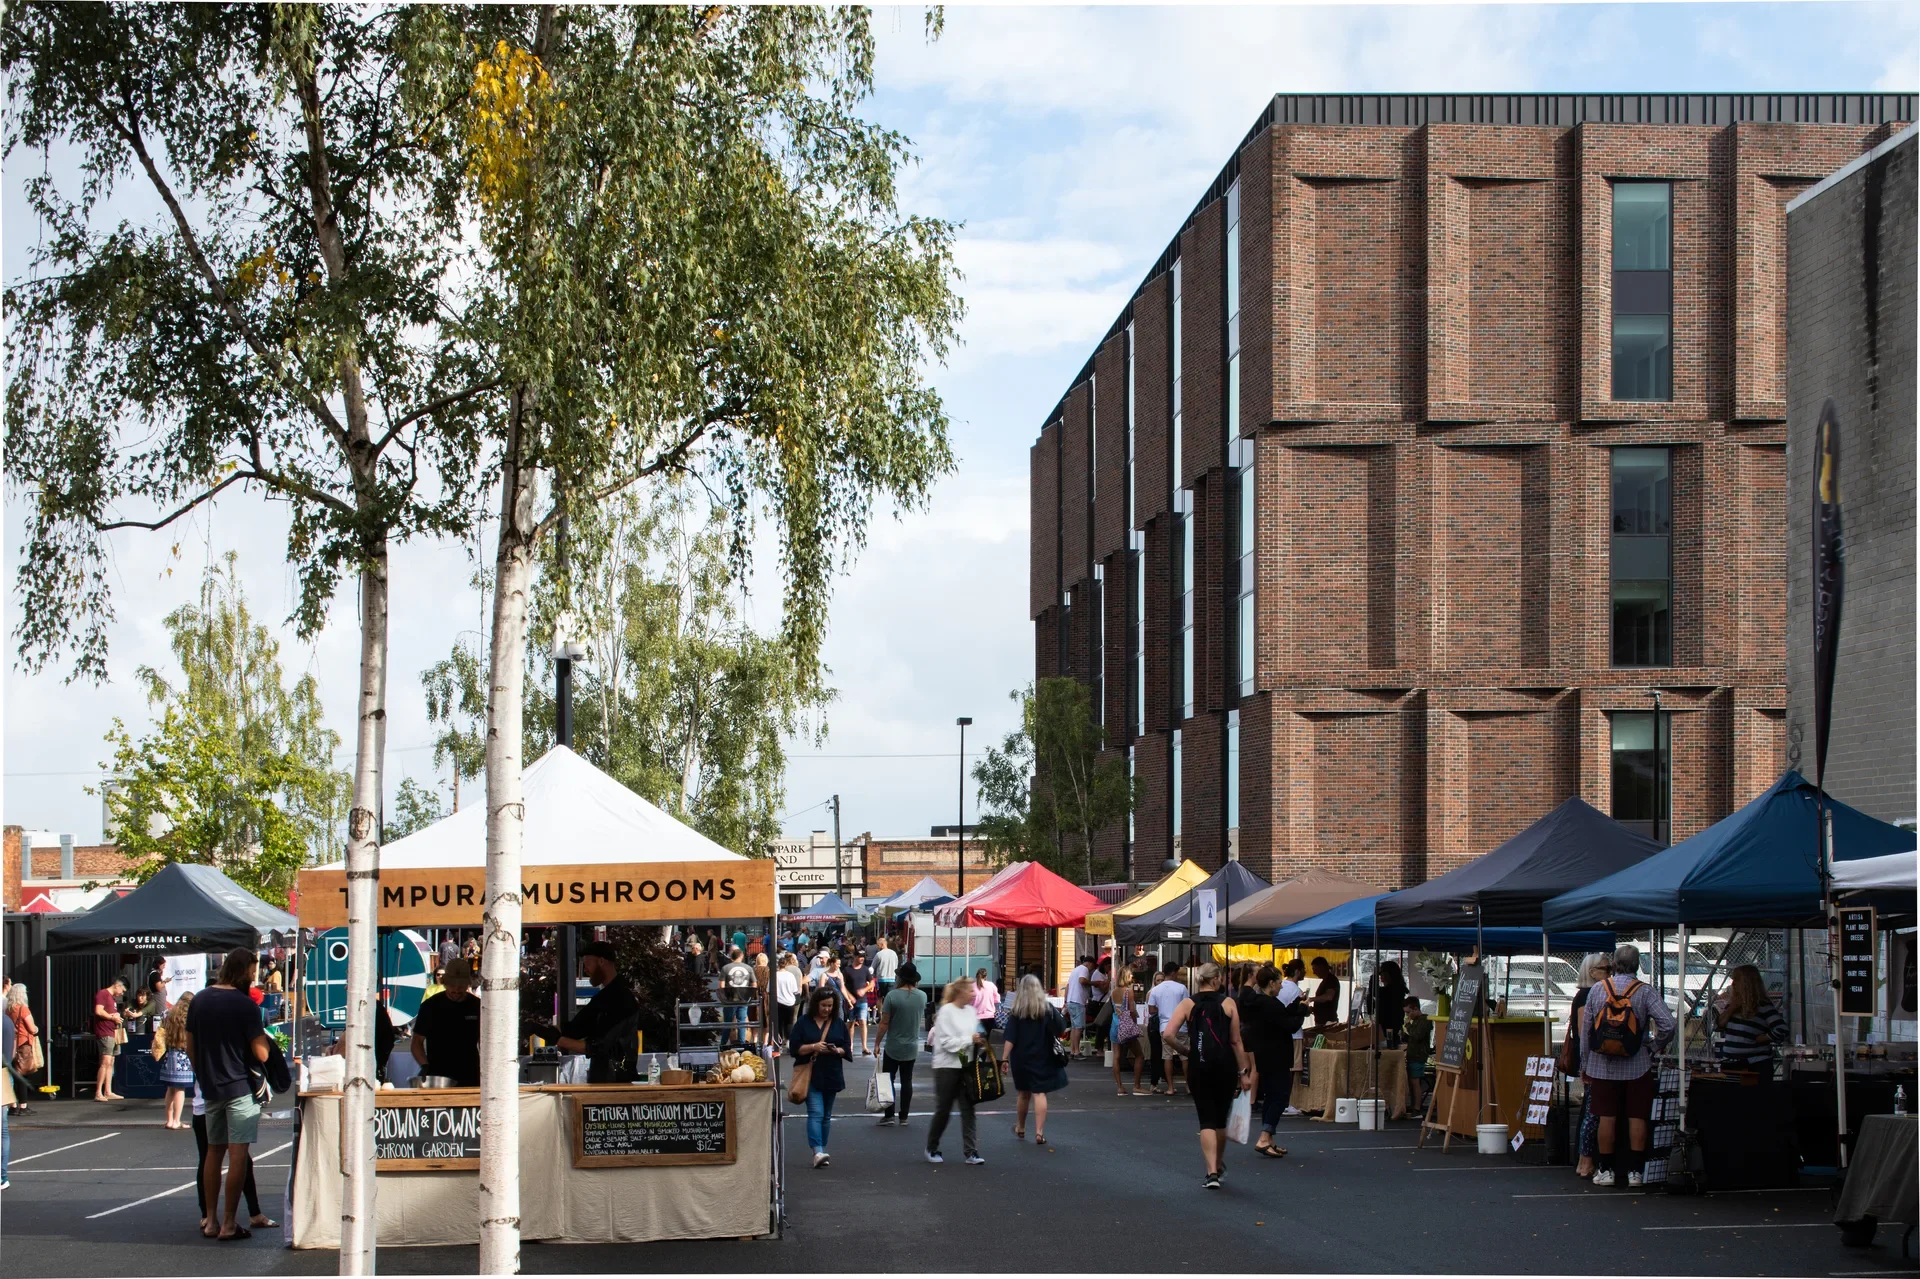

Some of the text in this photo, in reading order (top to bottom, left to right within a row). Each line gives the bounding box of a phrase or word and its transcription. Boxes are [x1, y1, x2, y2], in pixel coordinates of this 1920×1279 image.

[778, 845, 806, 853] PARK
[789, 871, 825, 881] Centre
[339, 878, 736, 909] TMPUR MUSHROOMS
[114, 935, 188, 944] PROVENANCE
[584, 1102, 725, 1122] TEMPURA MUSHROOM MEDLEY
[420, 1114, 430, 1129] &
[376, 1141, 465, 1159] SHROOM GARDEN
